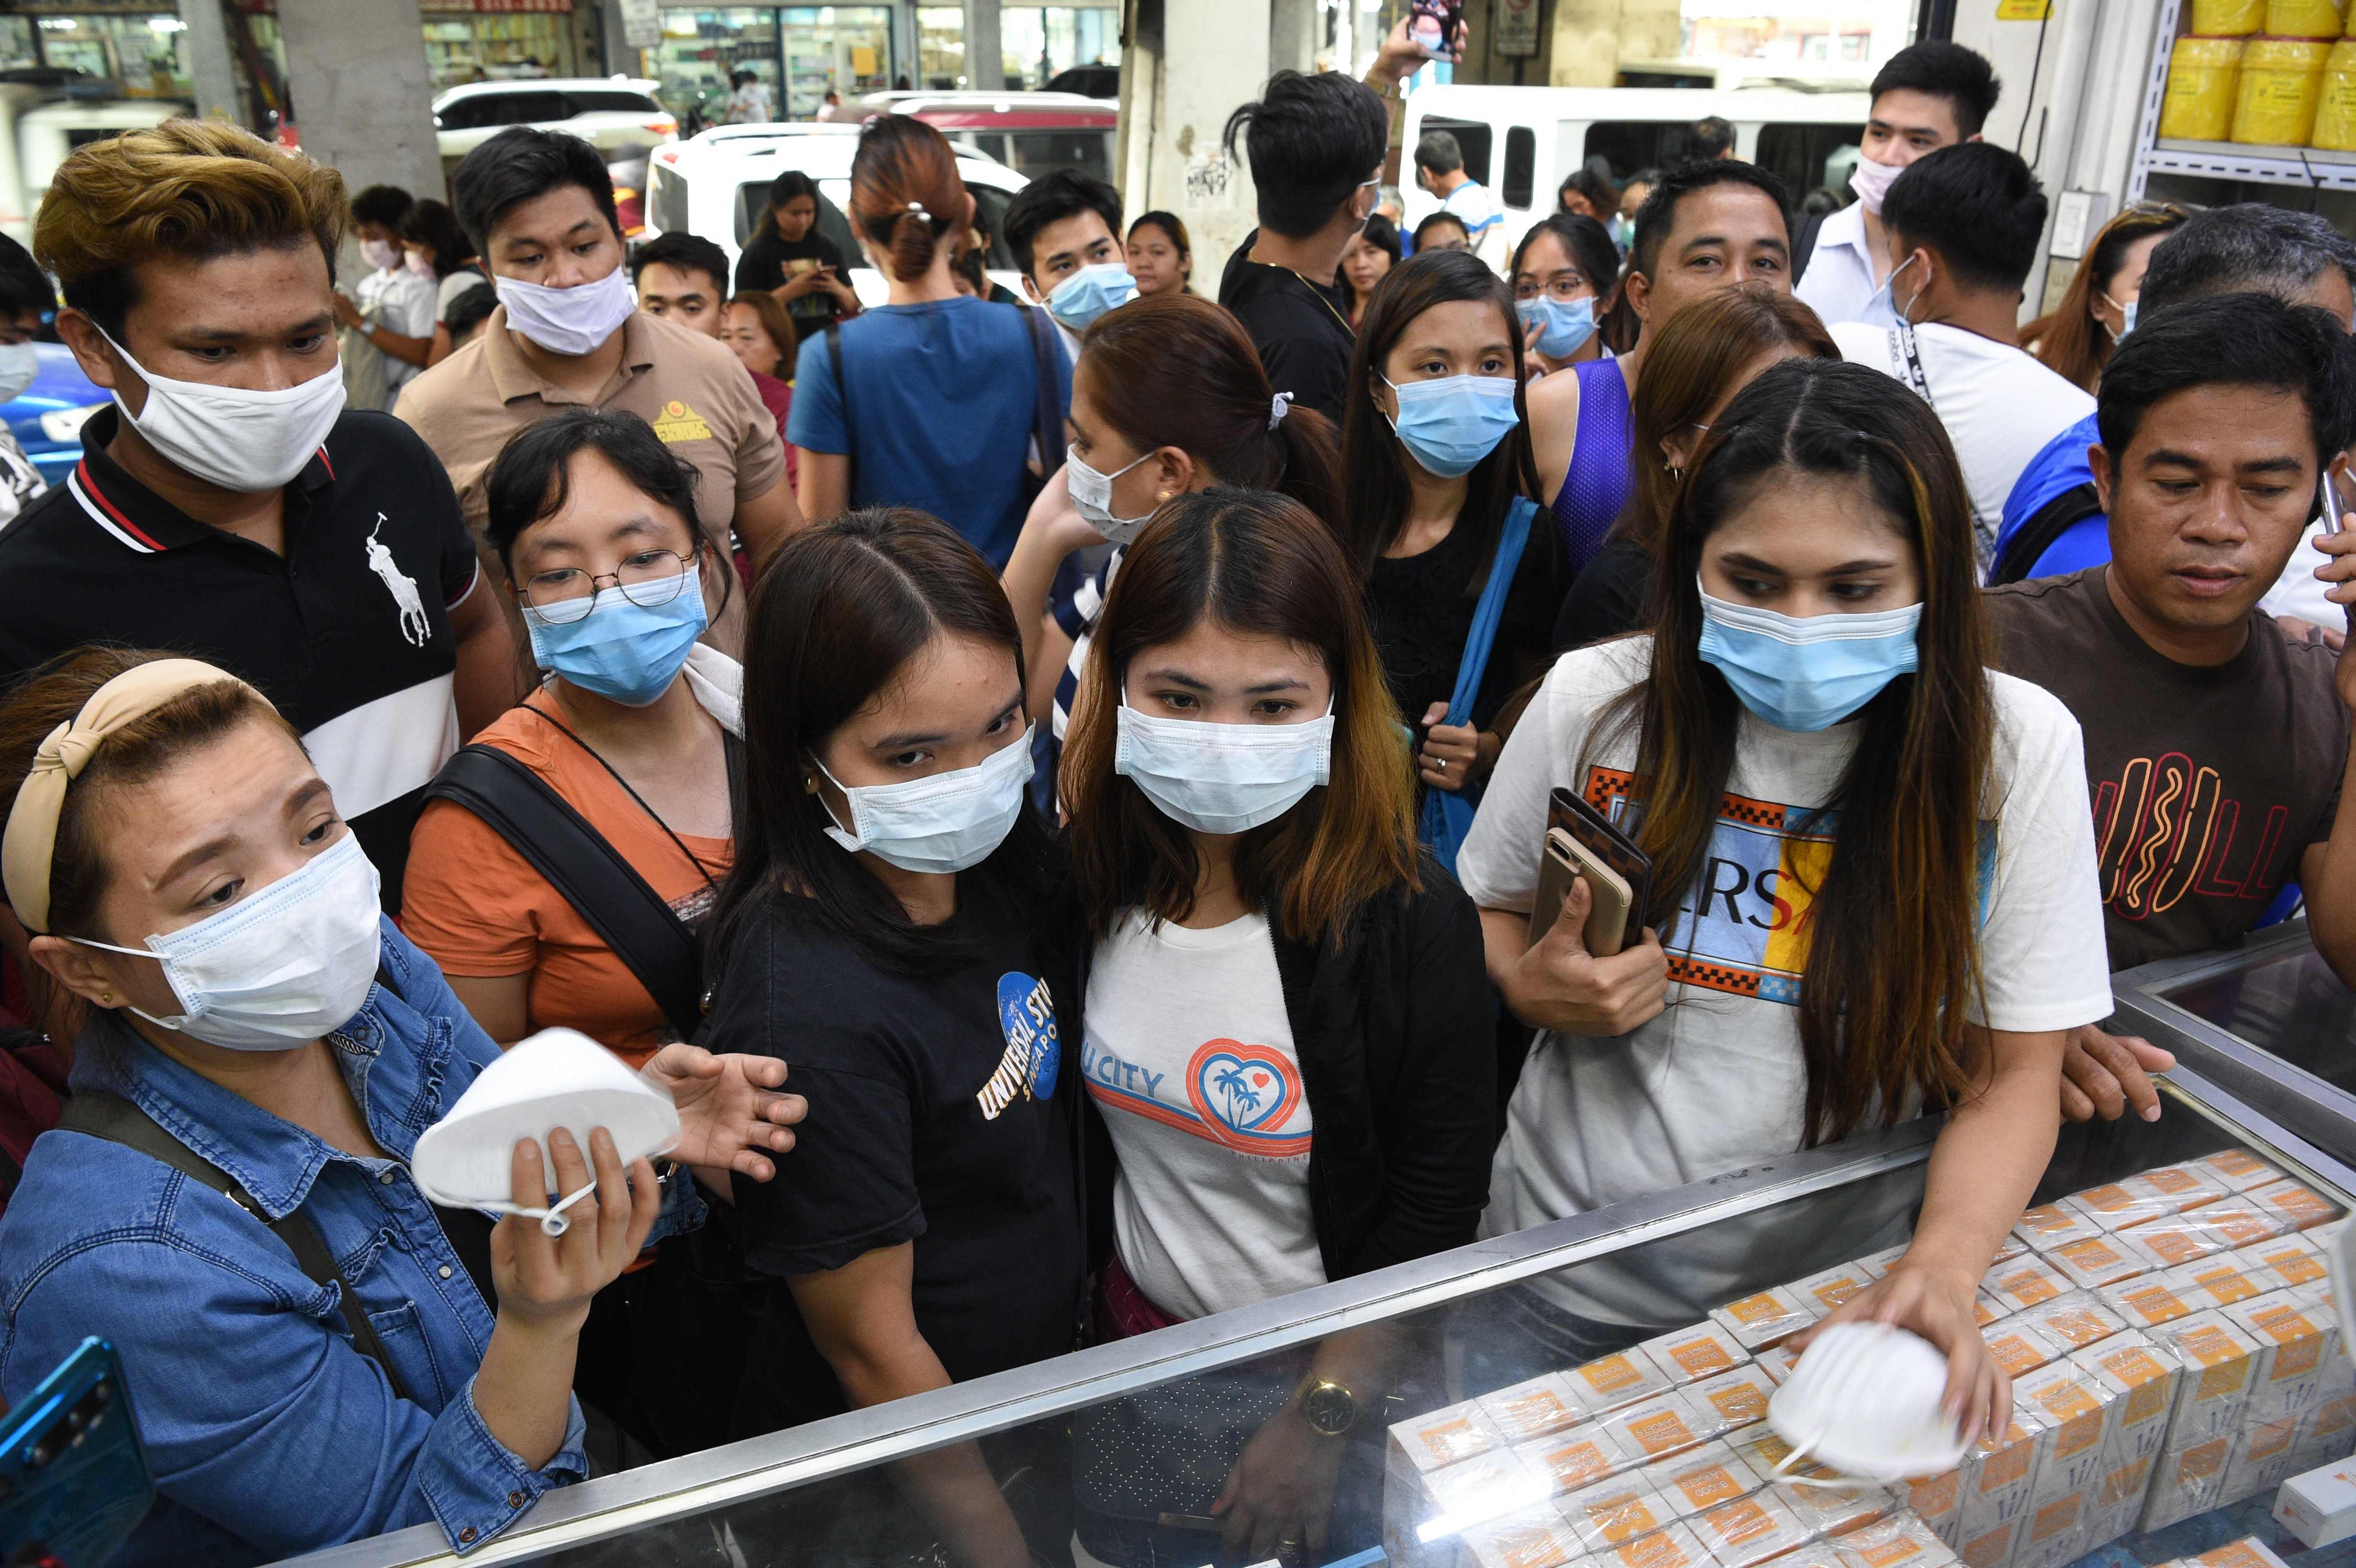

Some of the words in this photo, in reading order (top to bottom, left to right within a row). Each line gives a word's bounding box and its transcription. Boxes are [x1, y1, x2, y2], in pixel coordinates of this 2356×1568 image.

[976, 1011, 1036, 1121] UNIVERSAL
[1098, 1056, 1165, 1099] CITY
[2271, 1319, 2302, 1333] BLOOD
[1676, 1342, 1716, 1360] LANCETS
[1688, 1351, 1720, 1367] BLOOD
[1592, 1364, 1624, 1380] BLOOD
[1594, 1370, 1636, 1389] LANCETS
[1714, 1388, 1758, 1407] LANCETS
[1635, 1417, 1677, 1436] LANCETS
[1647, 1426, 1680, 1443] BLOOD
[1680, 1468, 1726, 1489] LANCETS
[1631, 1544, 1668, 1562] BLOOD
[1867, 1539, 1911, 1562] LANCETS
